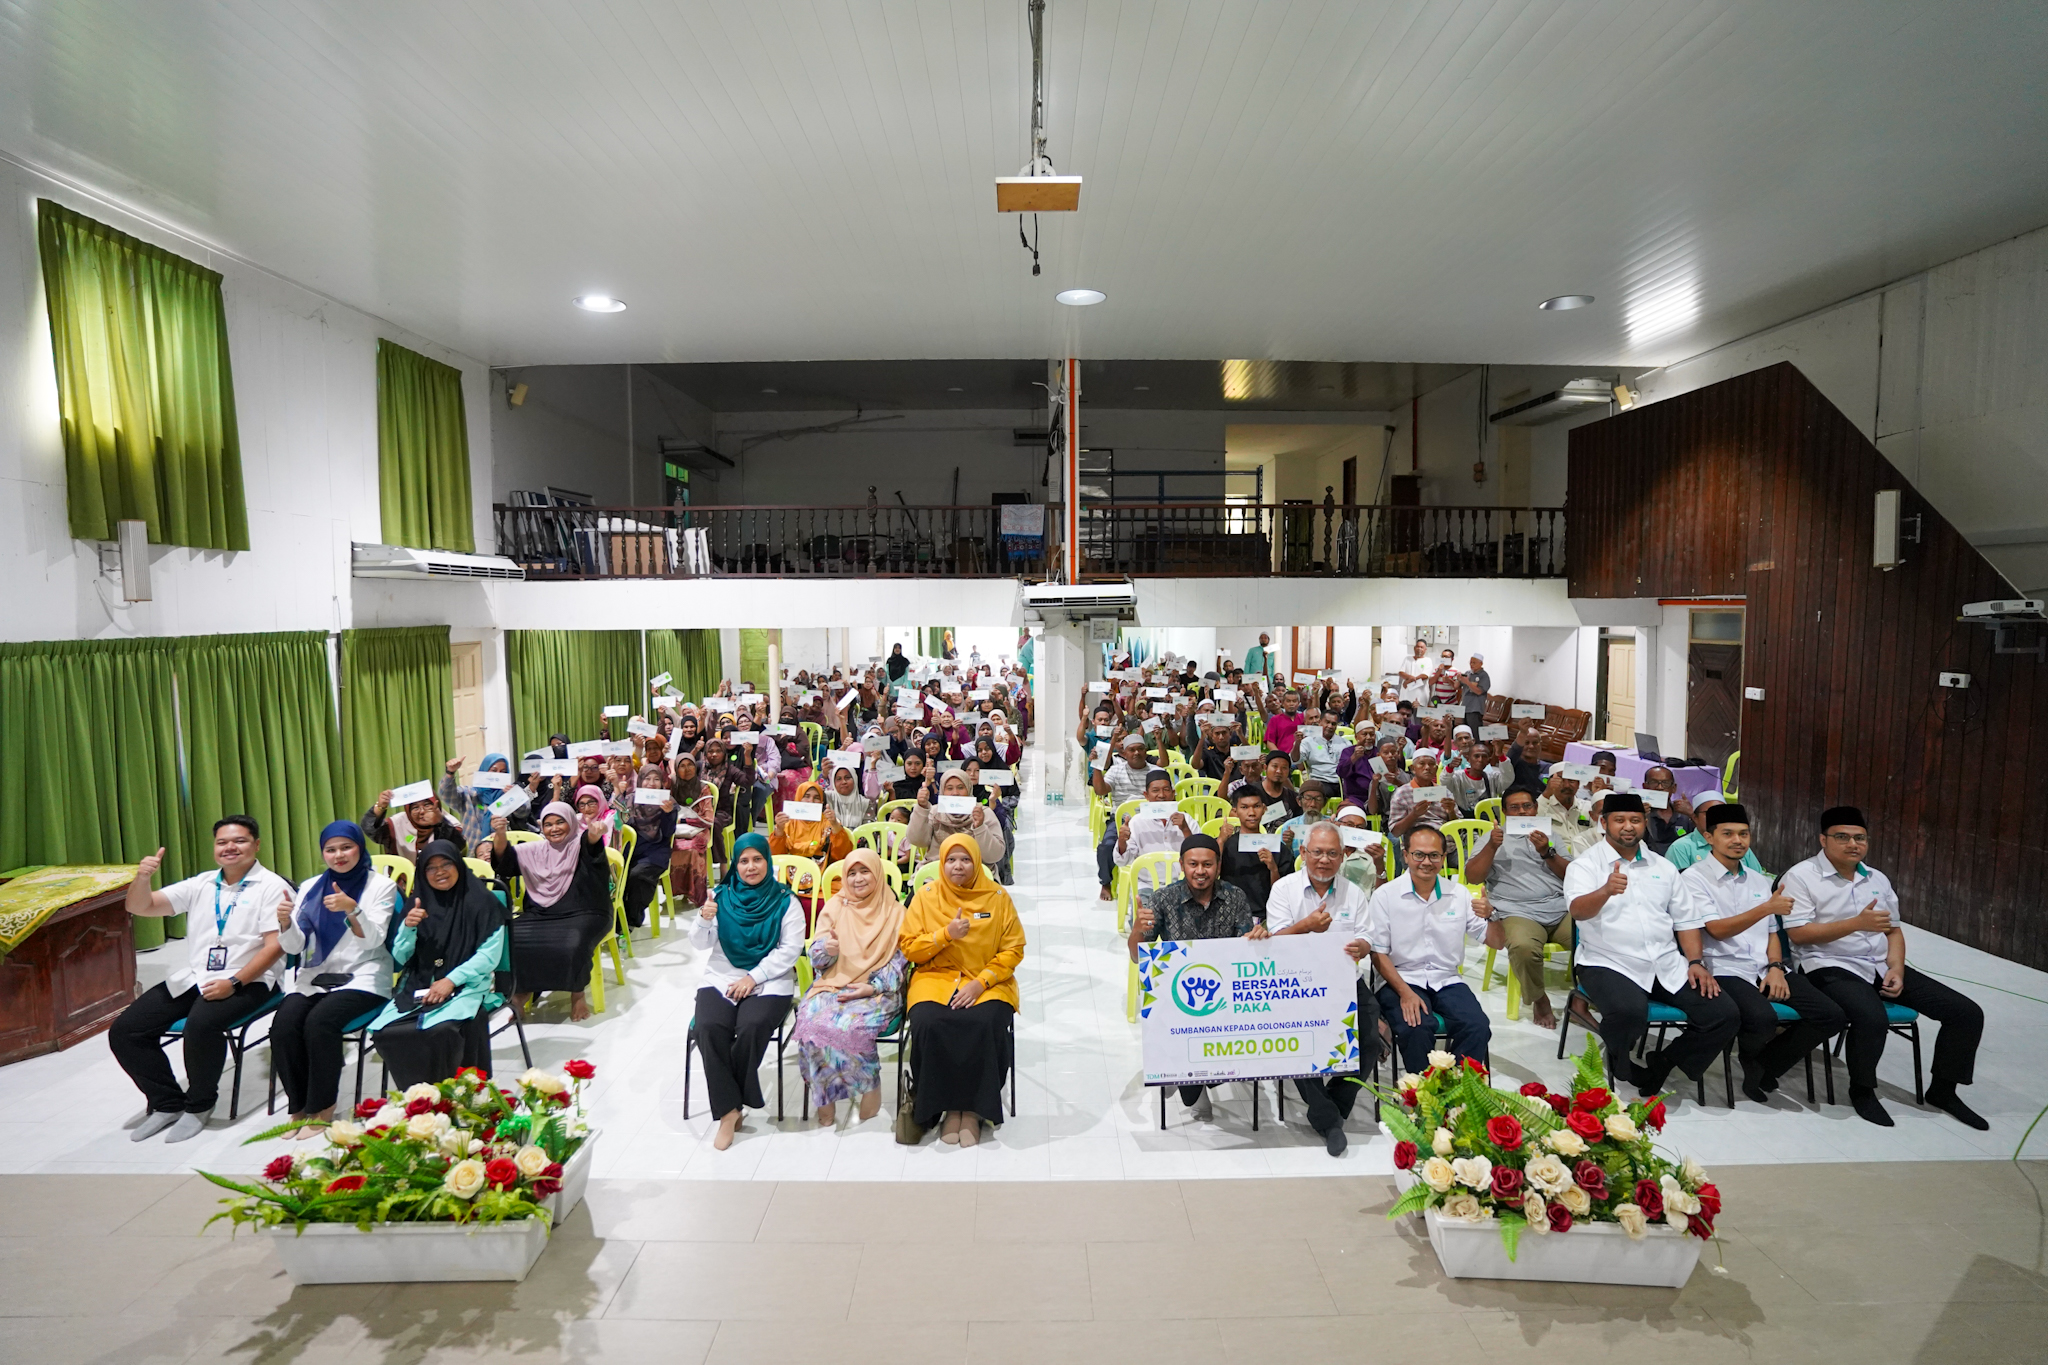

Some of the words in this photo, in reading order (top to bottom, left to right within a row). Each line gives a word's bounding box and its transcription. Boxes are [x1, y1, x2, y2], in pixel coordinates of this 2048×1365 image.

[1231, 957, 1275, 978] TDM
[1232, 977, 1300, 991] BERSAMA
[1233, 987, 1327, 1002] MASYARAKAT
[1234, 1002, 1272, 1014] PAKA
[1170, 1026, 1222, 1035] SUMBANGAN
[1223, 1023, 1256, 1032] KEPADA
[1257, 1020, 1302, 1030] GOLONGAN
[1303, 1019, 1330, 1028] ASNAF
[1203, 1037, 1299, 1057] RM20,000
